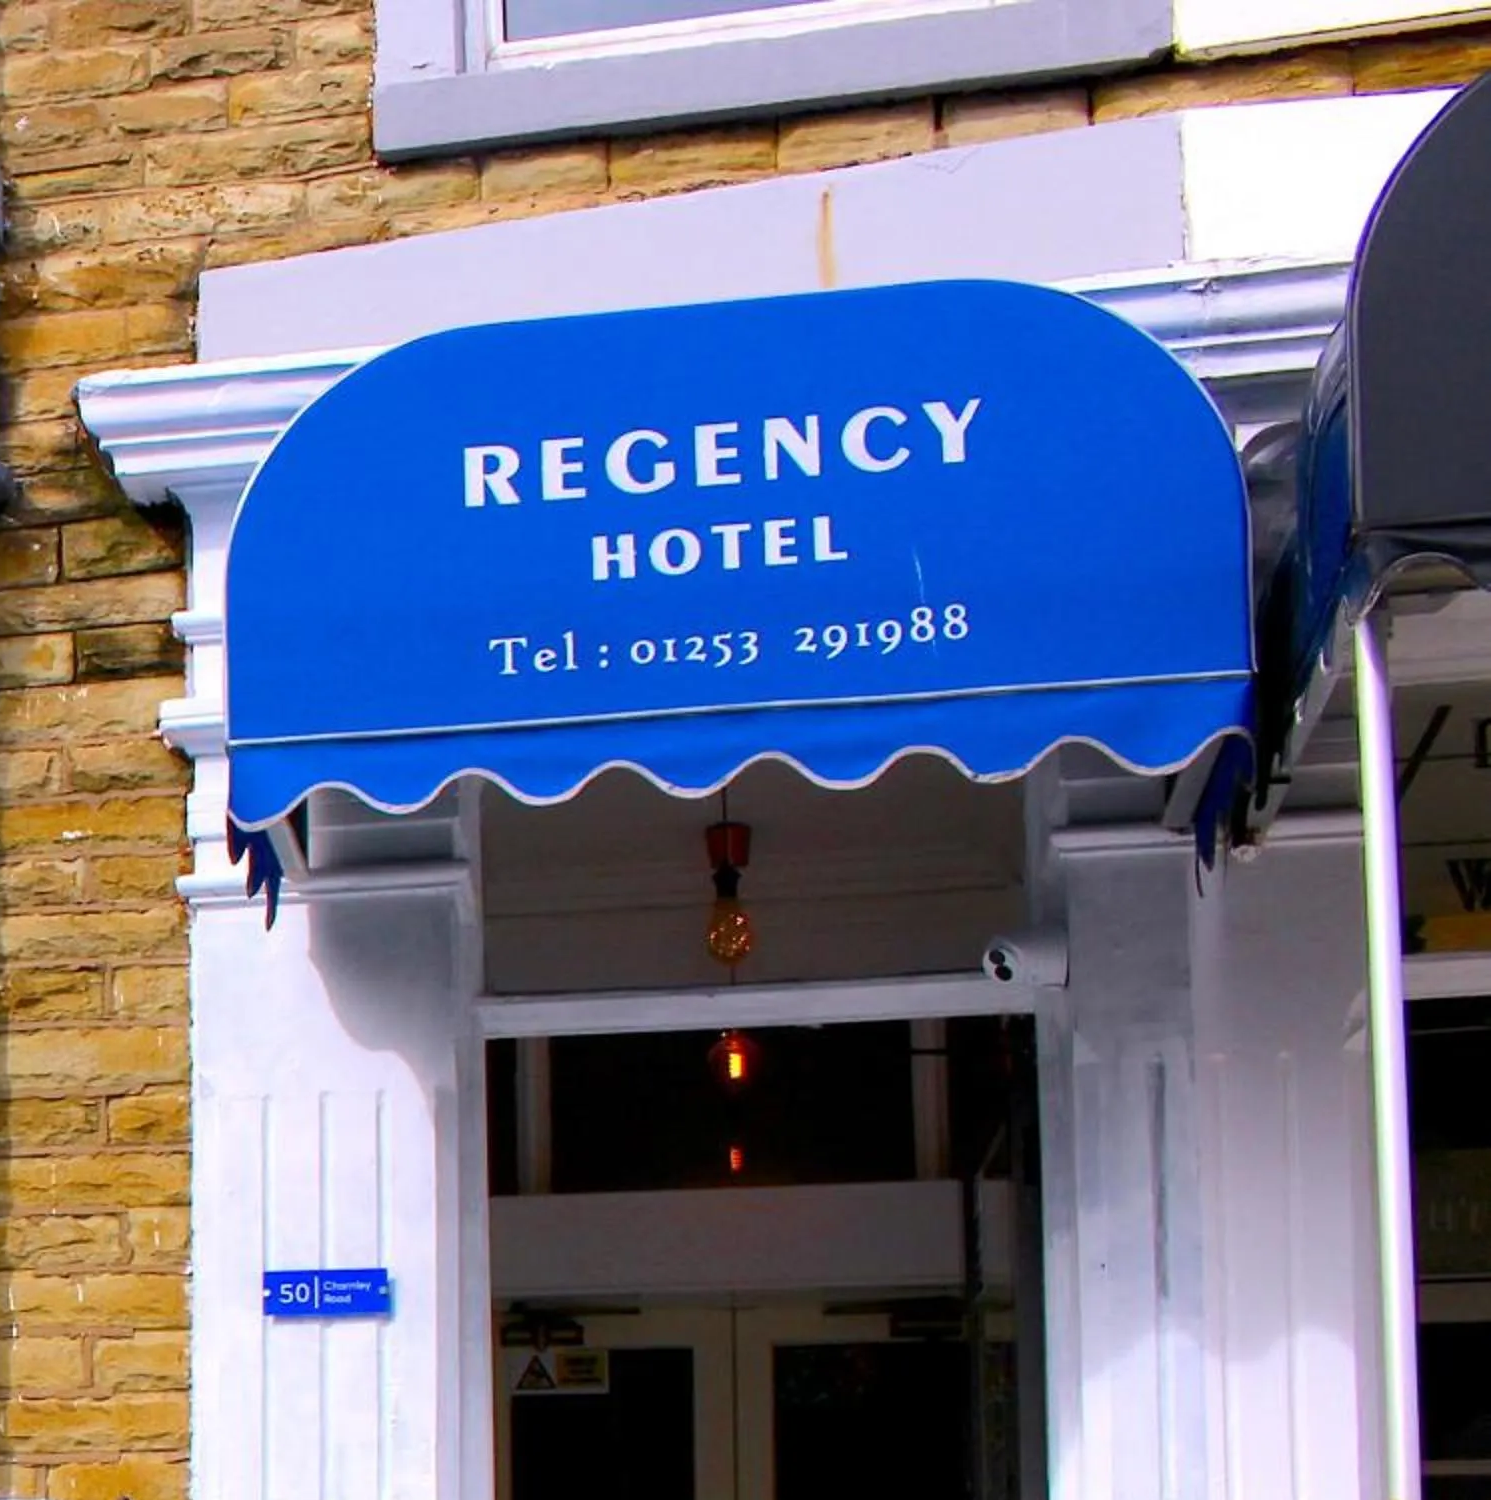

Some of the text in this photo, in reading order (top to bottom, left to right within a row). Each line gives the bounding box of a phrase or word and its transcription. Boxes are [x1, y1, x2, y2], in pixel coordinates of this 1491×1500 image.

[464, 398, 981, 508] REGENCY
[592, 515, 848, 581] HOTEL
[629, 630, 759, 668] 01253
[794, 603, 969, 659] 291988
[279, 1283, 310, 1304] 50
[323, 1294, 352, 1304] Road
